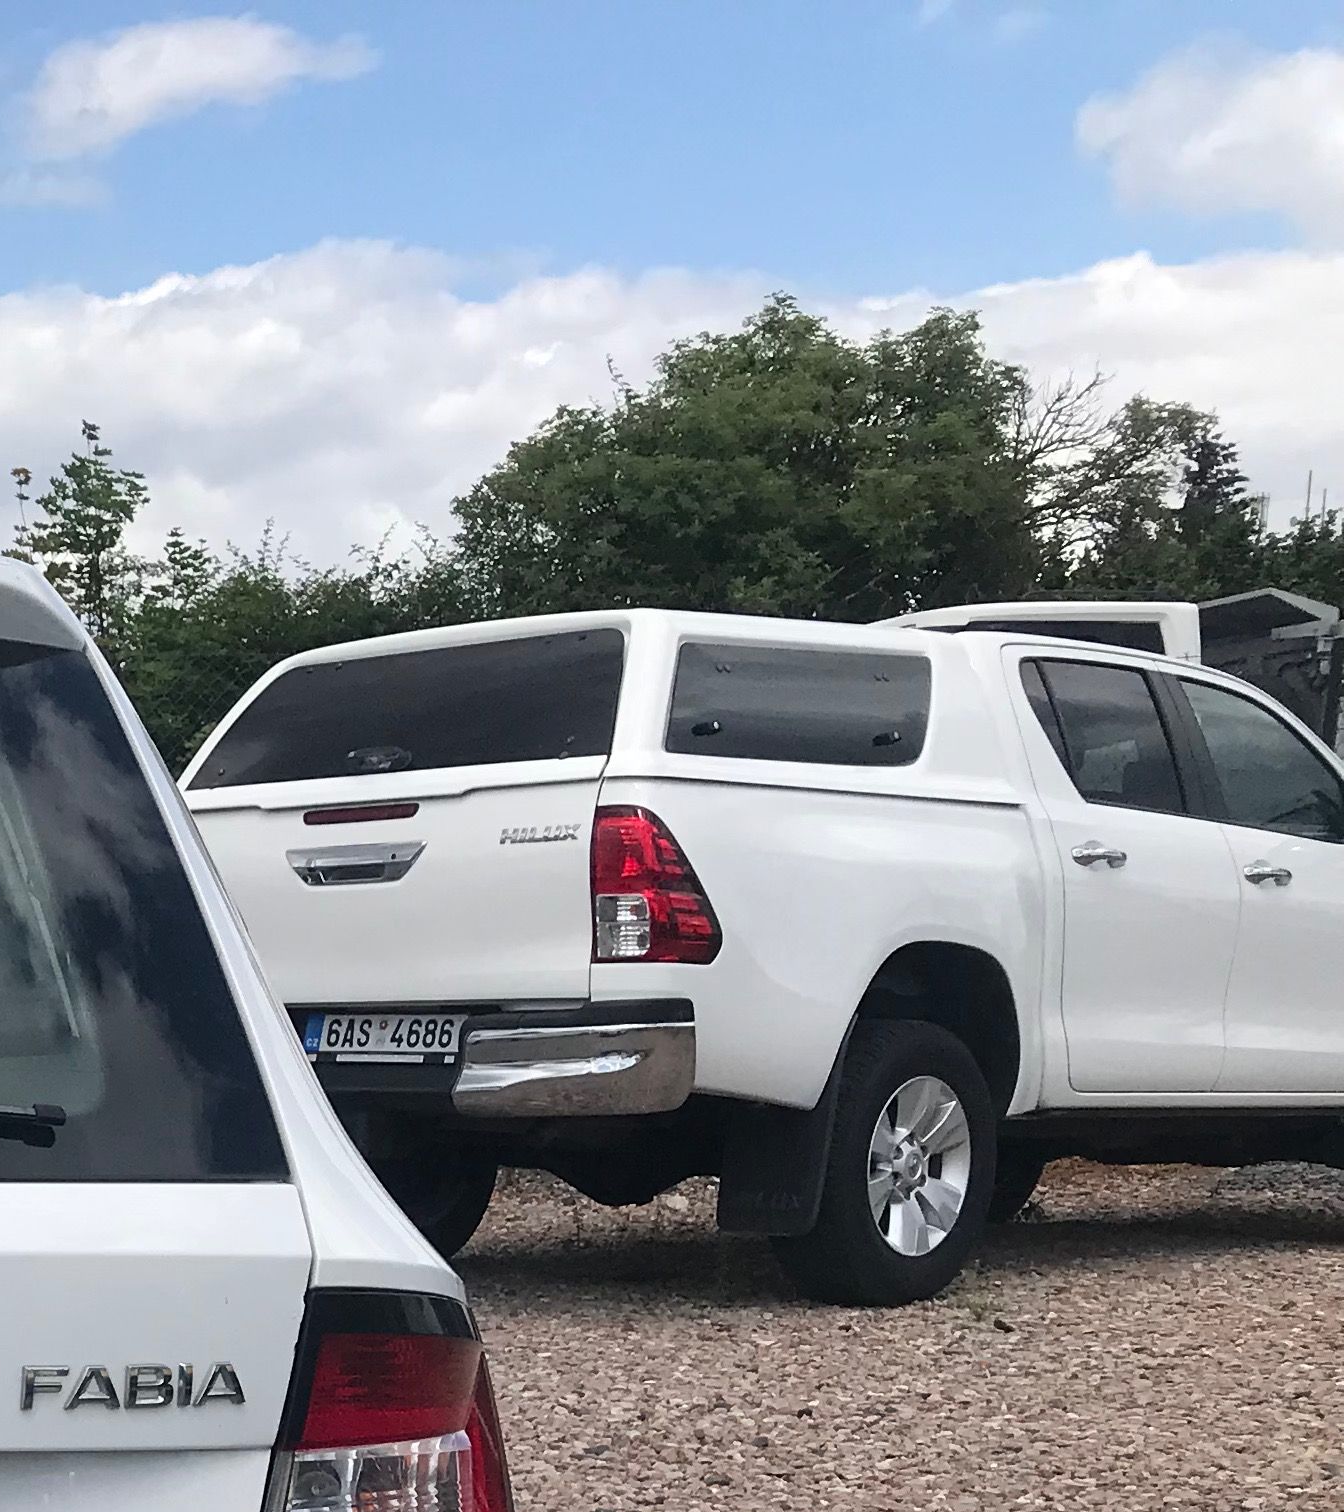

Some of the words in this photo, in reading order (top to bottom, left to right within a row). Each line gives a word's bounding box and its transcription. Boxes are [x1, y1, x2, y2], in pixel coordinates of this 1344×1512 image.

[499, 823, 581, 844] HILUX
[306, 1038, 319, 1048] CZ
[326, 1018, 372, 1048] 6AS
[390, 1018, 454, 1048] 4686
[20, 1361, 246, 1410] FABIA
